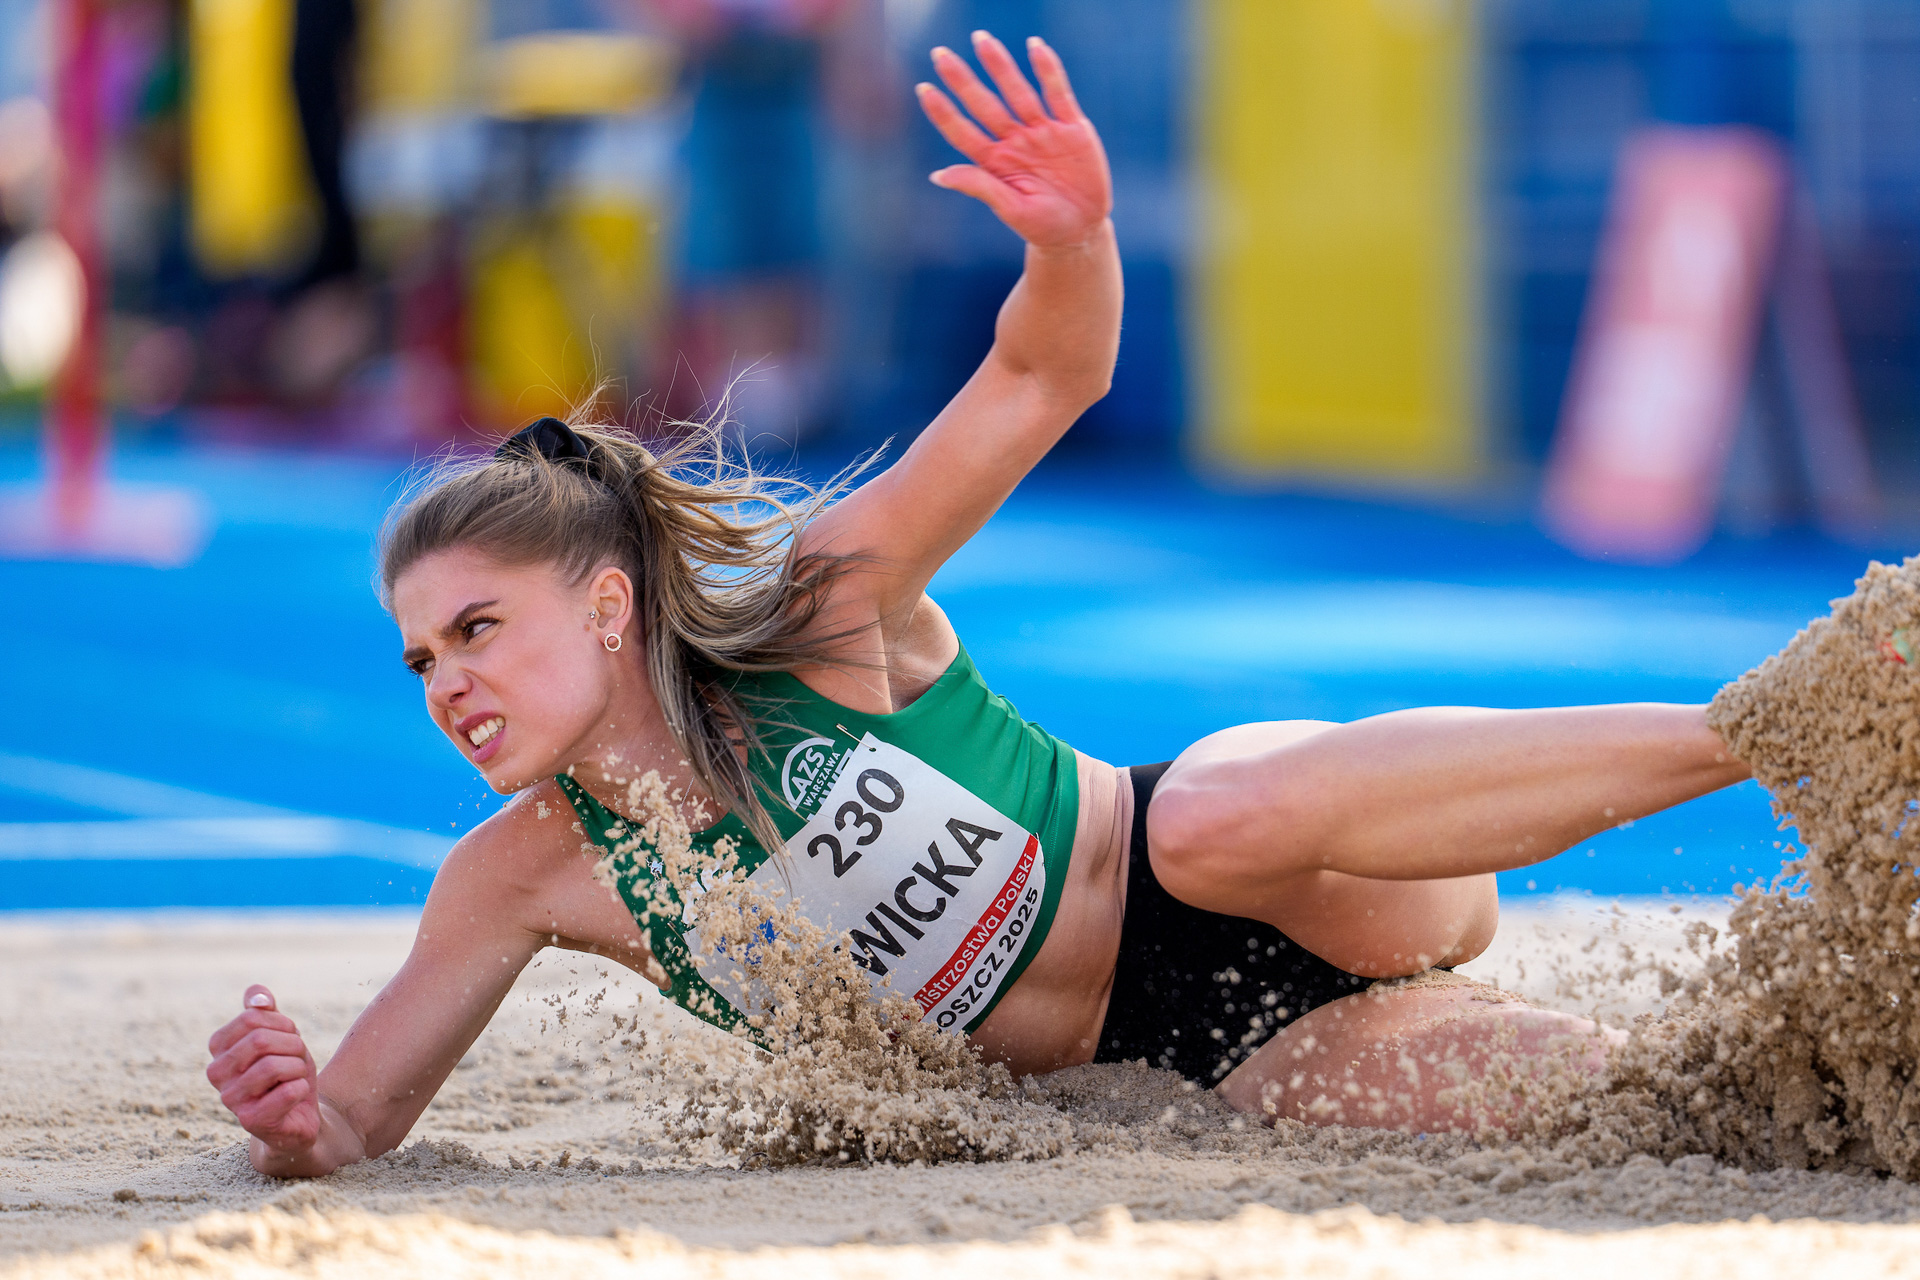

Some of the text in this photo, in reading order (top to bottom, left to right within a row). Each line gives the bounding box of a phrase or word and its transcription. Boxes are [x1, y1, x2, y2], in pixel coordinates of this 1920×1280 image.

[791, 747, 825, 808] AZS
[803, 752, 841, 807] WARSZAWA
[807, 768, 905, 878] 230
[849, 817, 1003, 976] WICKA
[995, 853, 1033, 914] Polski
[936, 887, 1038, 1032] OSZCZ 2025
